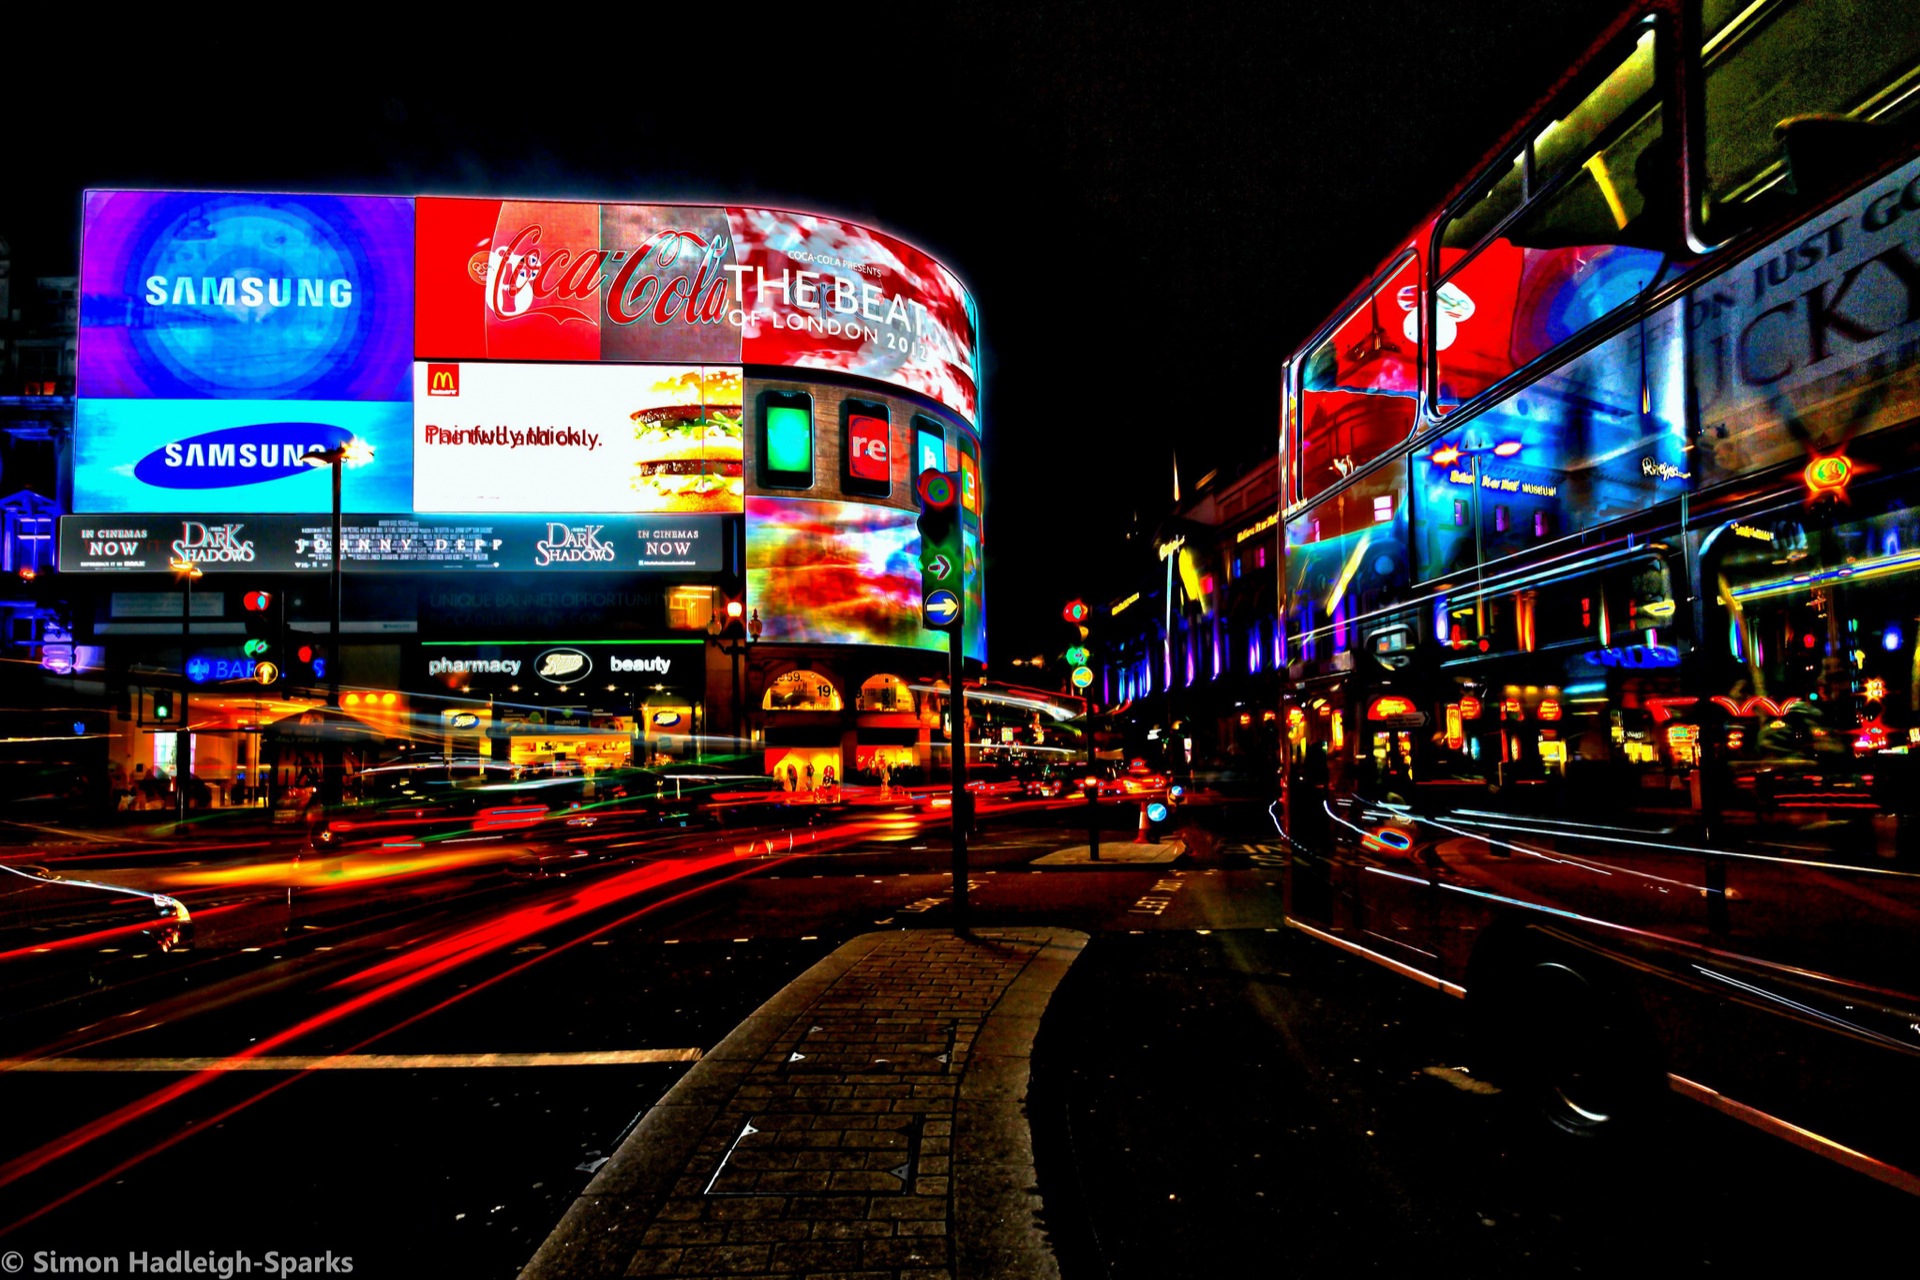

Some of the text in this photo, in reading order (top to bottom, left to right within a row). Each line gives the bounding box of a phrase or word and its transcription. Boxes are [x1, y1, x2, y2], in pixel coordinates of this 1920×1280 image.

[787, 250, 882, 278] COCA-COLA PRESENTS
[1751, 216, 1850, 303] JUST
[493, 223, 729, 326] Coca-Cola
[145, 275, 353, 308] SAMSUNG
[724, 264, 820, 309] THE
[834, 276, 928, 337] BEAT
[727, 309, 928, 363] OF LONDON 2012
[82, 529, 148, 539] IN CINEMAS
[182, 521, 244, 551] DARK
[436, 539, 503, 551] DEPP
[546, 522, 605, 550] DARK
[637, 530, 699, 539] IN CINEMAS
[89, 542, 139, 556] NOW
[171, 539, 256, 565] SHADOWS
[535, 541, 615, 566] SHADOWS
[646, 542, 691, 555] NOW
[429, 592, 495, 608] UNIQUE
[496, 592, 559, 608] BANNER
[429, 657, 521, 676] pharmacy
[610, 655, 671, 674] beauty
